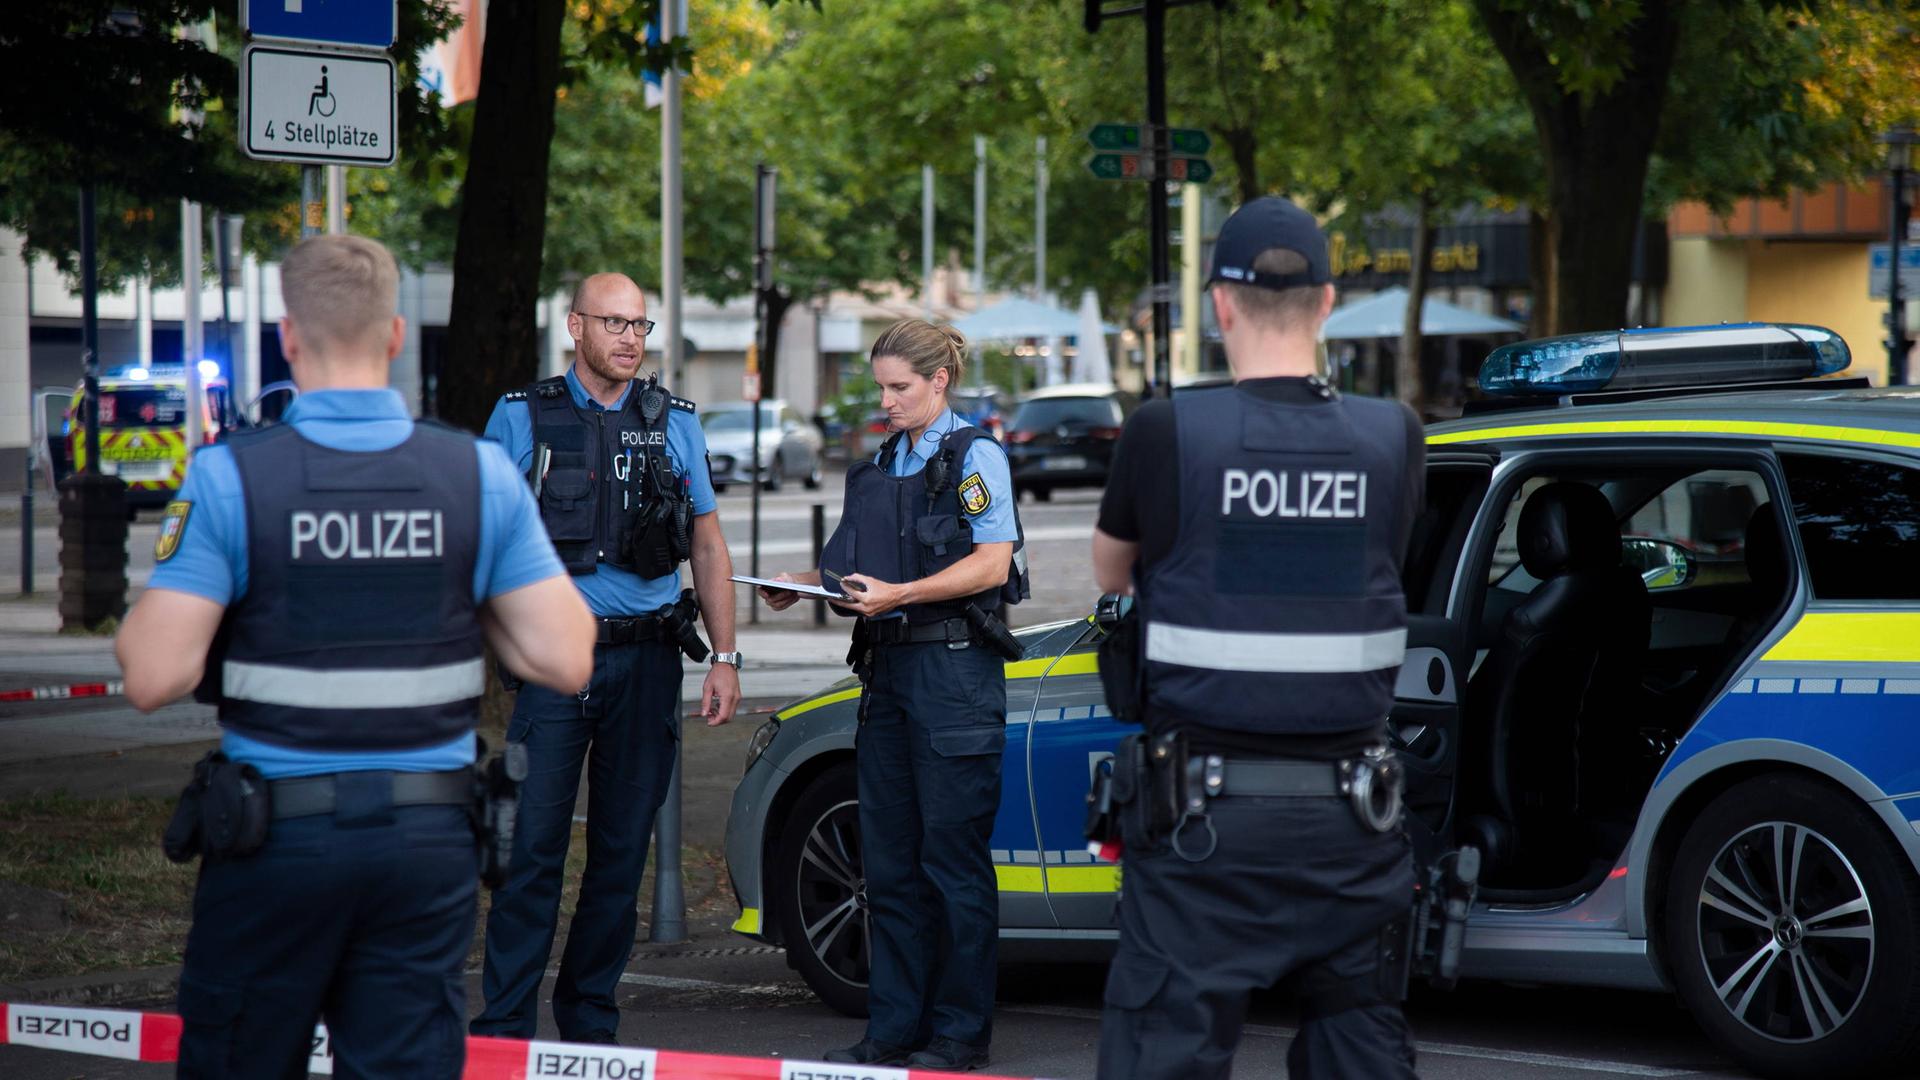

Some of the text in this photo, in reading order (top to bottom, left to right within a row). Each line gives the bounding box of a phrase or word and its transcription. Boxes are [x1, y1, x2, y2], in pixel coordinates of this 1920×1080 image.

[264, 119, 379, 150] 4 Stellplätze
[621, 430, 667, 446] POLIZEI
[1221, 468, 1368, 519] POLIZEI
[290, 508, 443, 560] POLIZEI
[16, 1014, 131, 1043] POLIZEI
[536, 1052, 645, 1080] POLIZEI
